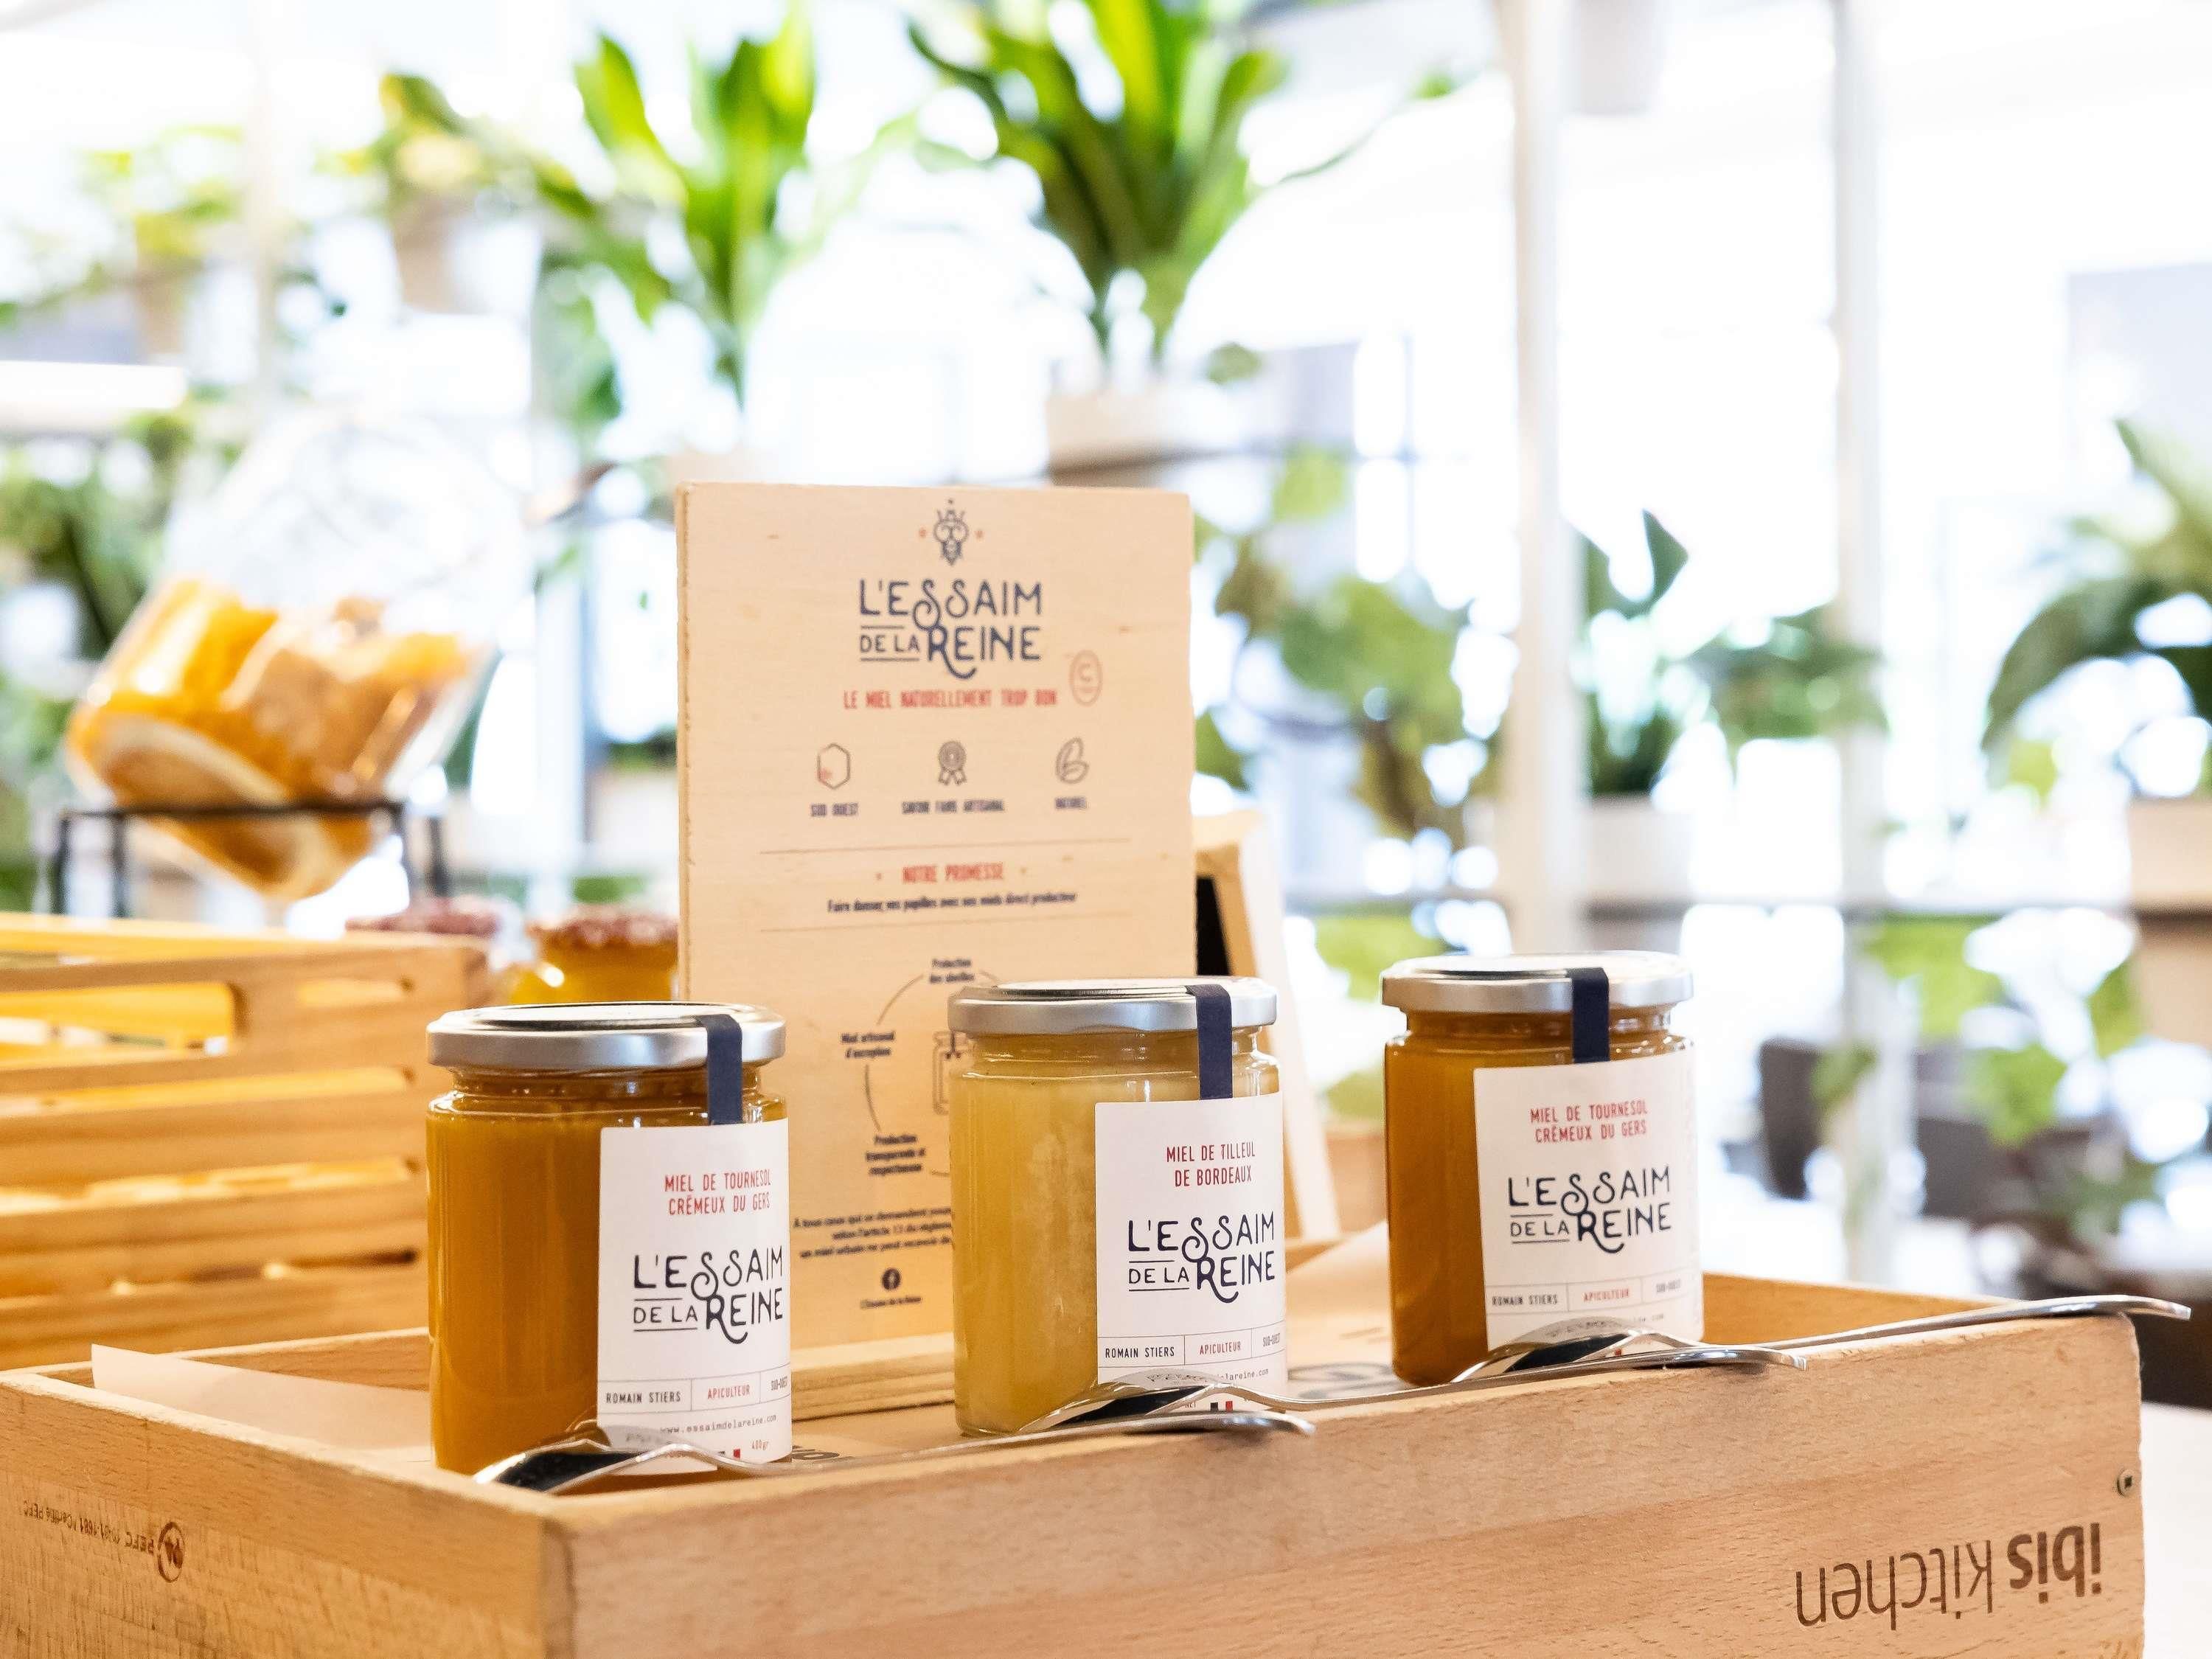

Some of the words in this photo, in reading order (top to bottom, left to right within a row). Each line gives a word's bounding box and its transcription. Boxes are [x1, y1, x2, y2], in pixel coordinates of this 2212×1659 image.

[859, 579, 1043, 630] L'ESSAIM
[860, 634, 888, 653] DE
[894, 634, 920, 653] LA
[928, 625, 1041, 680] REINE
[844, 690, 858, 709] LE
[902, 864, 937, 883] NOTRE
[945, 862, 1004, 881] PROMESSE
[1530, 1107, 1559, 1123] MIEL
[1566, 1105, 1581, 1121] DE
[1588, 1100, 1647, 1119] TOURNESOL
[1601, 1123, 1615, 1139] DU
[1622, 1120, 1646, 1136] GERS
[1166, 1146, 1195, 1163] MIEL
[1201, 1145, 1214, 1161] DE
[1221, 1141, 1256, 1160] TILLEUL
[664, 1174, 694, 1192] MIEL
[703, 1174, 716, 1192] DE
[723, 1168, 771, 1189] TOURNESOL
[1175, 1169, 1190, 1187] DE
[1197, 1166, 1252, 1186] BORDEAUX
[1508, 1166, 1670, 1216] L'ESSAIM
[733, 1194, 746, 1212] DU
[752, 1192, 771, 1211] GERS
[1128, 1211, 1274, 1263] L'ESSAIM
[1510, 1221, 1536, 1237] DE
[1544, 1220, 1570, 1235] LA
[1577, 1202, 1672, 1254] REINE
[633, 1245, 783, 1301] L'ESSAIM
[1128, 1267, 1156, 1284] DE
[1164, 1266, 1190, 1284] LA
[1197, 1251, 1276, 1304] REINE
[633, 1307, 661, 1324] DE
[671, 1305, 698, 1322] LA
[706, 1287, 783, 1344] REINE
[1105, 1347, 1139, 1359] ROMAIN
[1144, 1346, 1175, 1358] STIERS
[1199, 1341, 1242, 1355] APICULTEUR
[606, 1392, 642, 1404] ROMAIN
[649, 1391, 681, 1403] STIERS
[707, 1384, 751, 1399] APICULTEUR
[2007, 1523, 2102, 1604] ibis
[1795, 1540, 1993, 1631] kitchen
